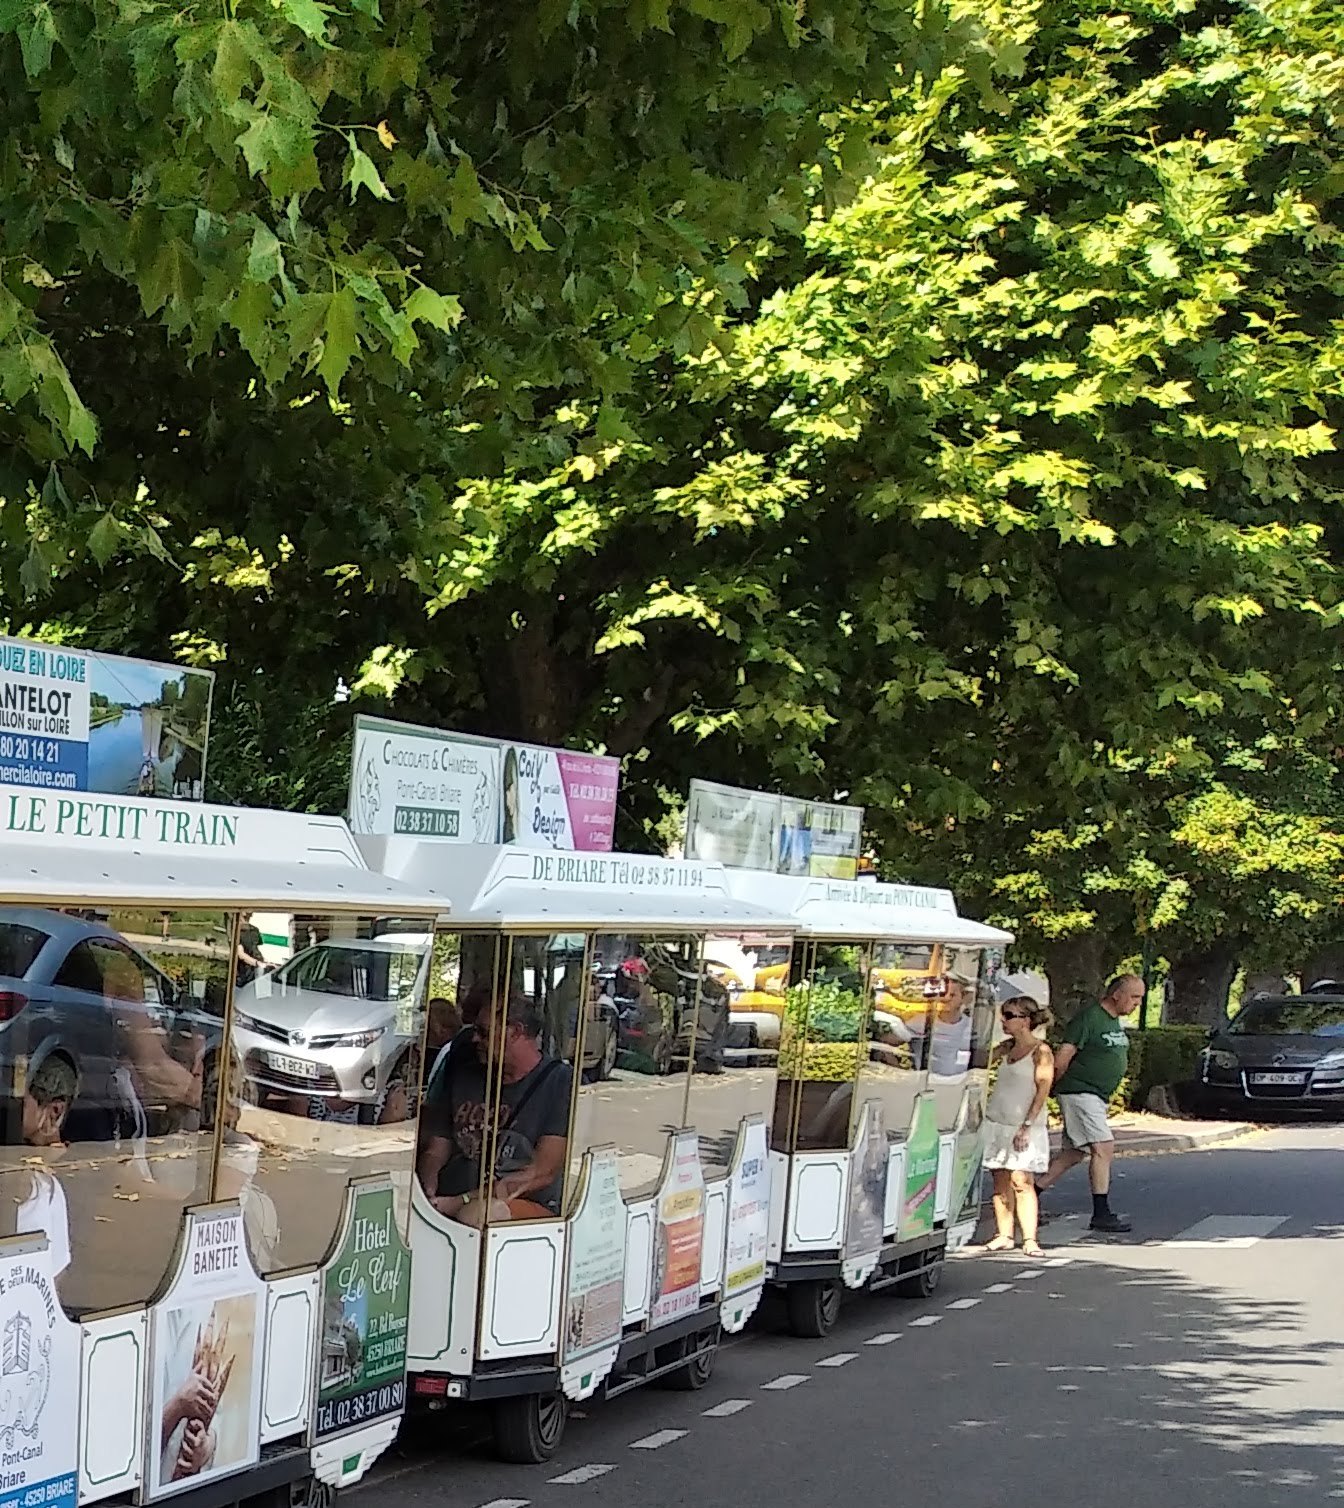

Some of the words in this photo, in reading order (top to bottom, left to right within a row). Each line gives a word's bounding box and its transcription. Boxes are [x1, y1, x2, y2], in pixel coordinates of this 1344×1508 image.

[28, 653, 46, 676] EN
[49, 654, 86, 683] LOIRE
[27, 718, 42, 732] sur
[44, 717, 70, 735] LOIRE
[0, 735, 14, 758] 80
[15, 738, 29, 760] 20
[31, 740, 45, 762] 14
[47, 742, 59, 763] 21
[431, 749, 439, 771] &
[6, 795, 47, 833] LE
[54, 799, 148, 840] PETIT
[155, 809, 239, 847] TRAIN
[396, 810, 407, 829] 02
[408, 811, 421, 832] 38
[422, 812, 434, 832] 37
[434, 812, 446, 833] 10
[446, 814, 458, 833] 58
[531, 855, 554, 881] DE
[556, 857, 607, 884] BRIARE
[610, 861, 629, 885] Tél
[631, 866, 644, 885] 02
[647, 866, 660, 886] 38
[662, 867, 675, 886] 37
[678, 869, 688, 886] 11
[690, 869, 703, 887] 94
[196, 1218, 237, 1248] MAISON
[353, 1207, 391, 1254] Hôtel
[10, 1265, 23, 1277] DES
[193, 1244, 239, 1276] BANETTE
[338, 1259, 367, 1303] Le
[368, 1249, 403, 1304] Cerf
[8, 1276, 24, 1289] DEUX
[25, 1266, 56, 1329] MARINES
[317, 1405, 336, 1432] Tél.
[337, 1399, 350, 1425] 02
[351, 1395, 365, 1421] 38
[365, 1392, 378, 1416] 37
[378, 1388, 391, 1411] 00
[1, 1441, 43, 1467] Pont-Canal
[46, 1477, 74, 1501] BRIARE
